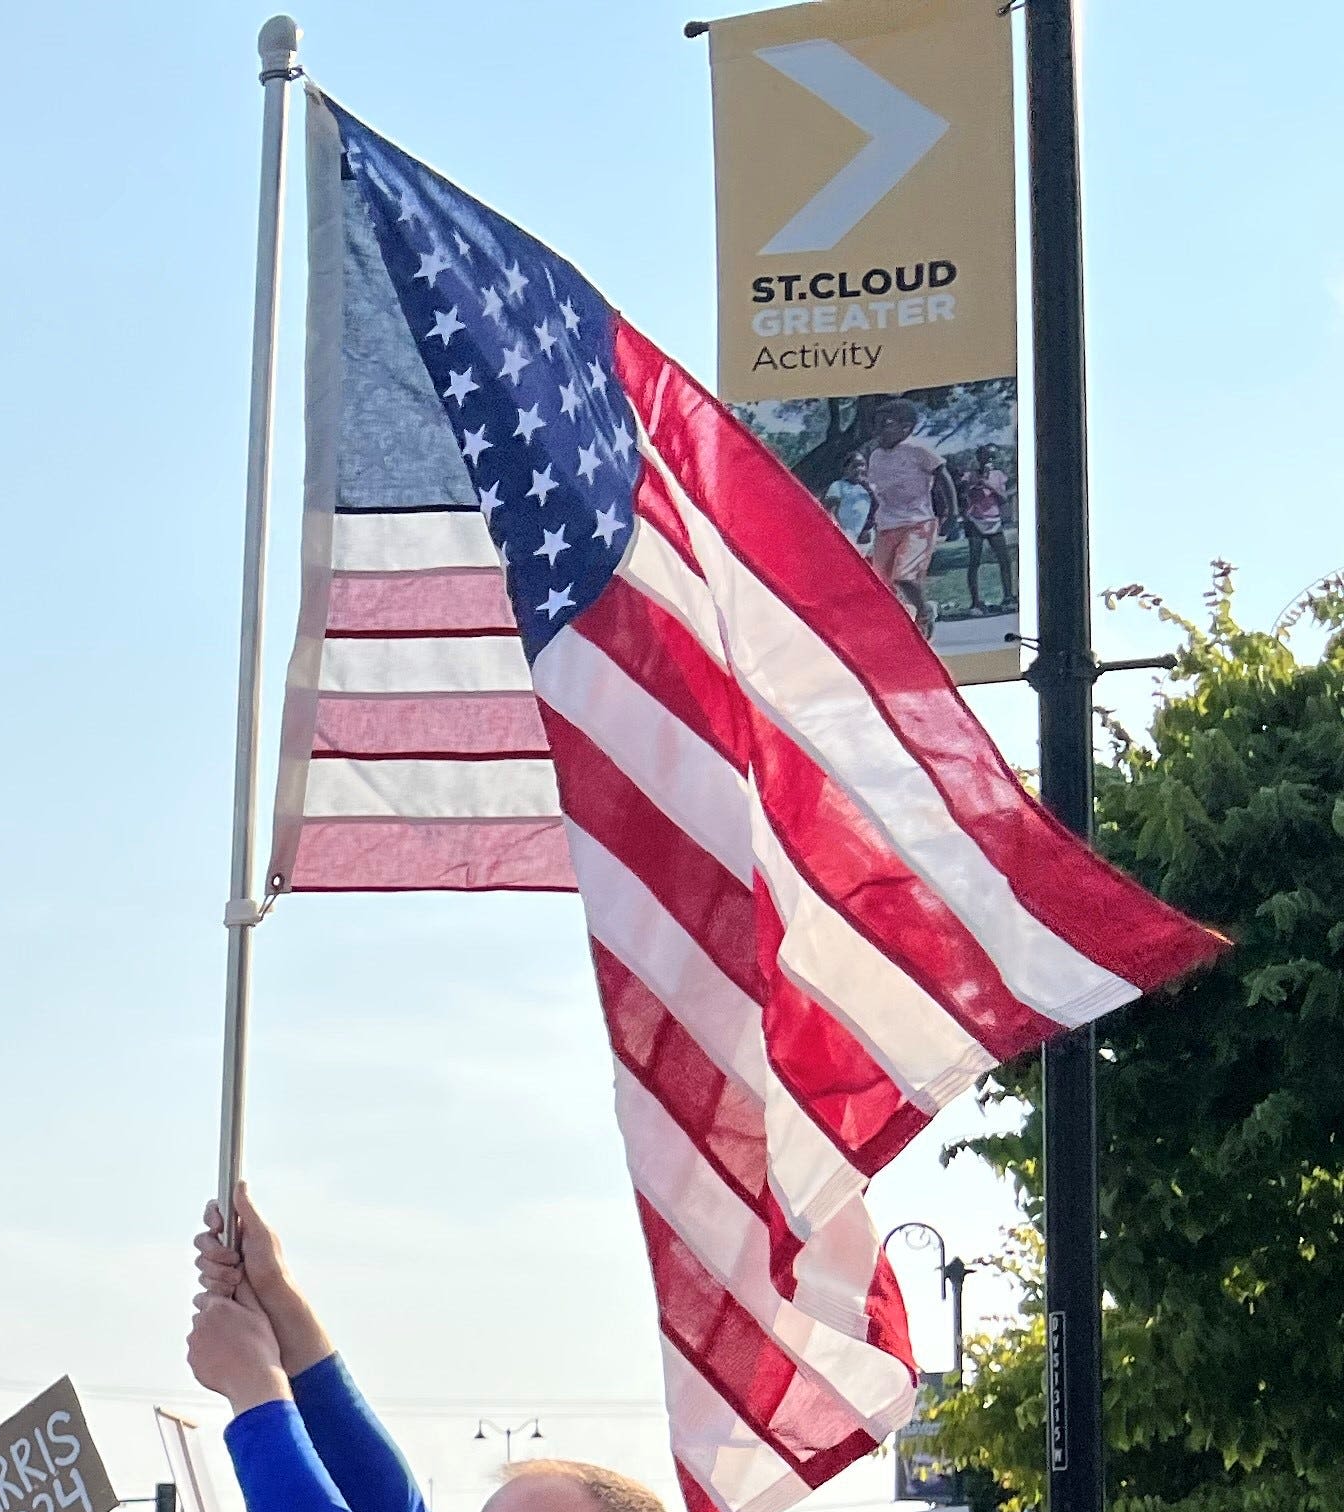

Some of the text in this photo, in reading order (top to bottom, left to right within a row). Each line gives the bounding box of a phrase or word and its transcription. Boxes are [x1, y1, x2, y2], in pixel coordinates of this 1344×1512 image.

[752, 260, 957, 303] ST.CLOUD
[752, 293, 956, 337] GREATER
[752, 341, 883, 373] Activity
